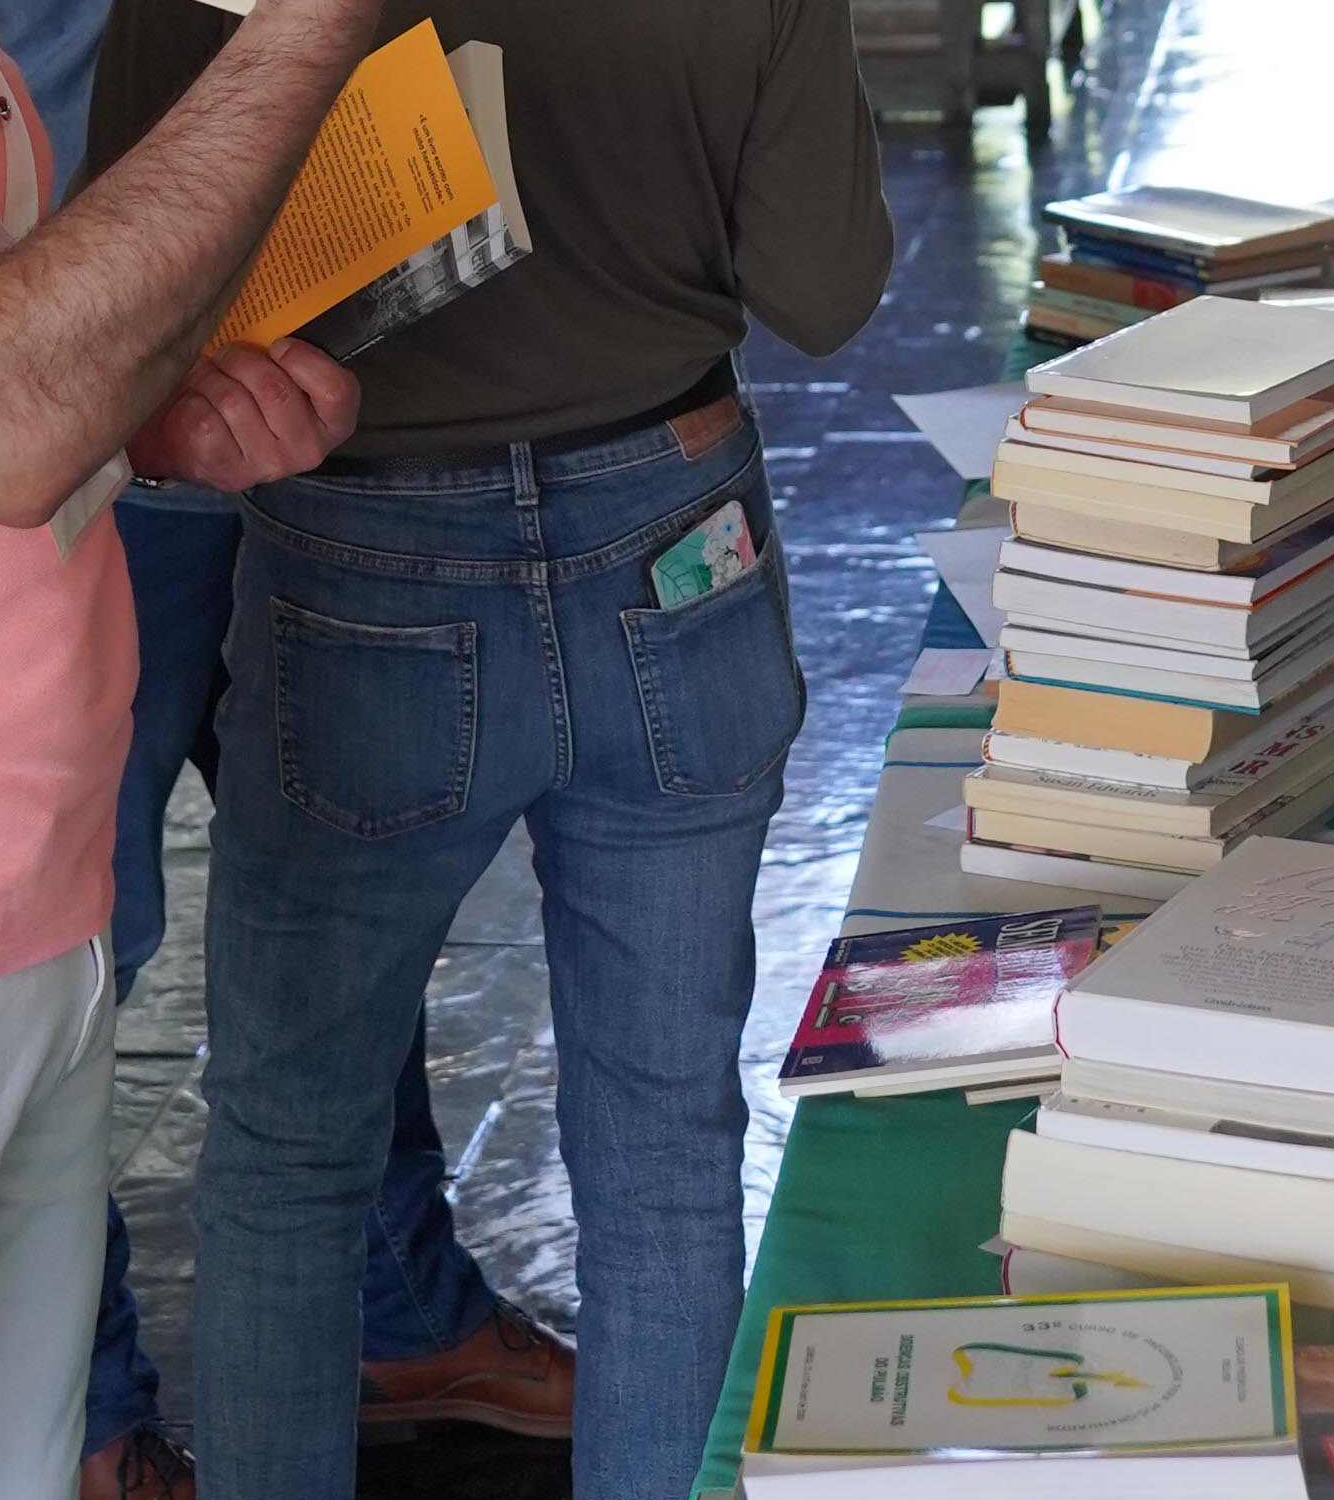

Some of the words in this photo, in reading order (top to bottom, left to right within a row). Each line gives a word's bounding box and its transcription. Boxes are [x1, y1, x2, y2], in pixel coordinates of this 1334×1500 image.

[426, 136, 438, 156] livro
[432, 154, 448, 183] escrito
[442, 181, 455, 201] com
